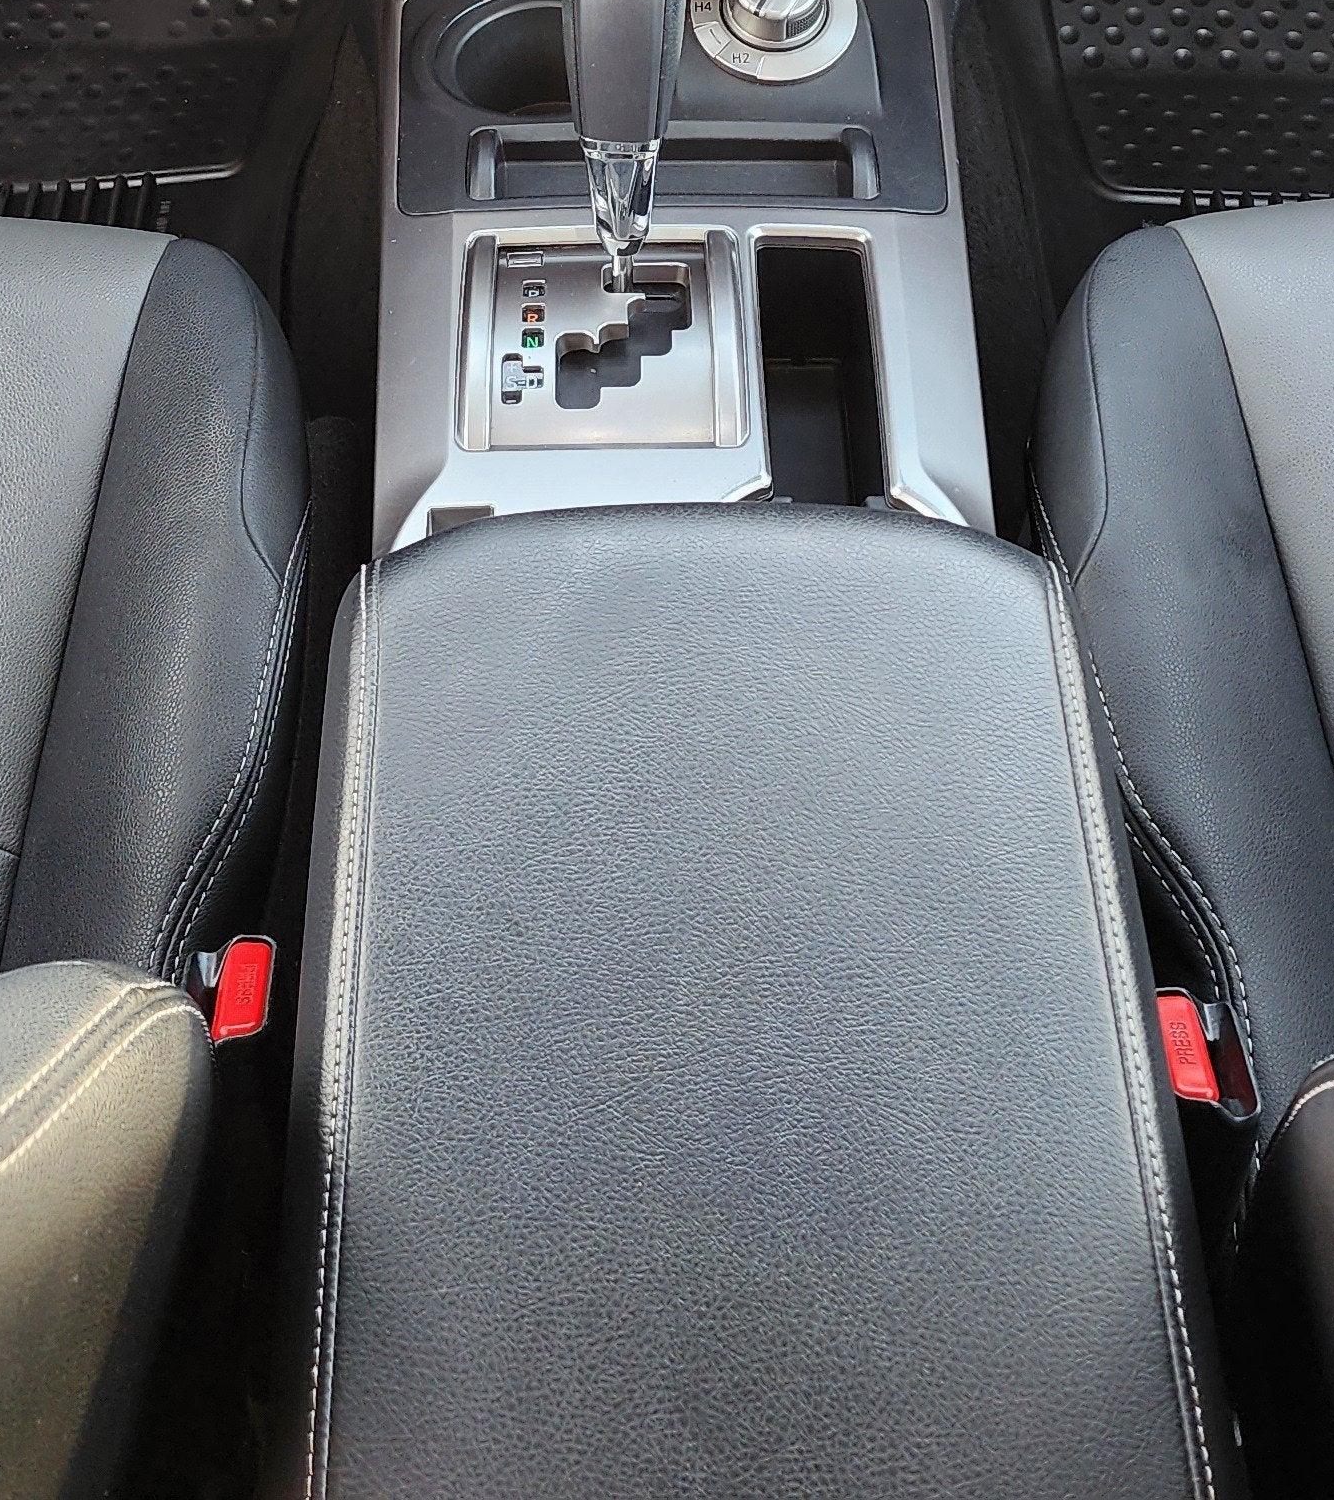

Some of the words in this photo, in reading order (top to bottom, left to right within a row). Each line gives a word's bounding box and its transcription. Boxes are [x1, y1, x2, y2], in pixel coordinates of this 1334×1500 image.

[694, 1, 712, 13] H4
[732, 52, 750, 64] H2
[527, 313, 539, 323] R
[527, 336, 539, 348] N
[1169, 1021, 1197, 1065] PRESS
